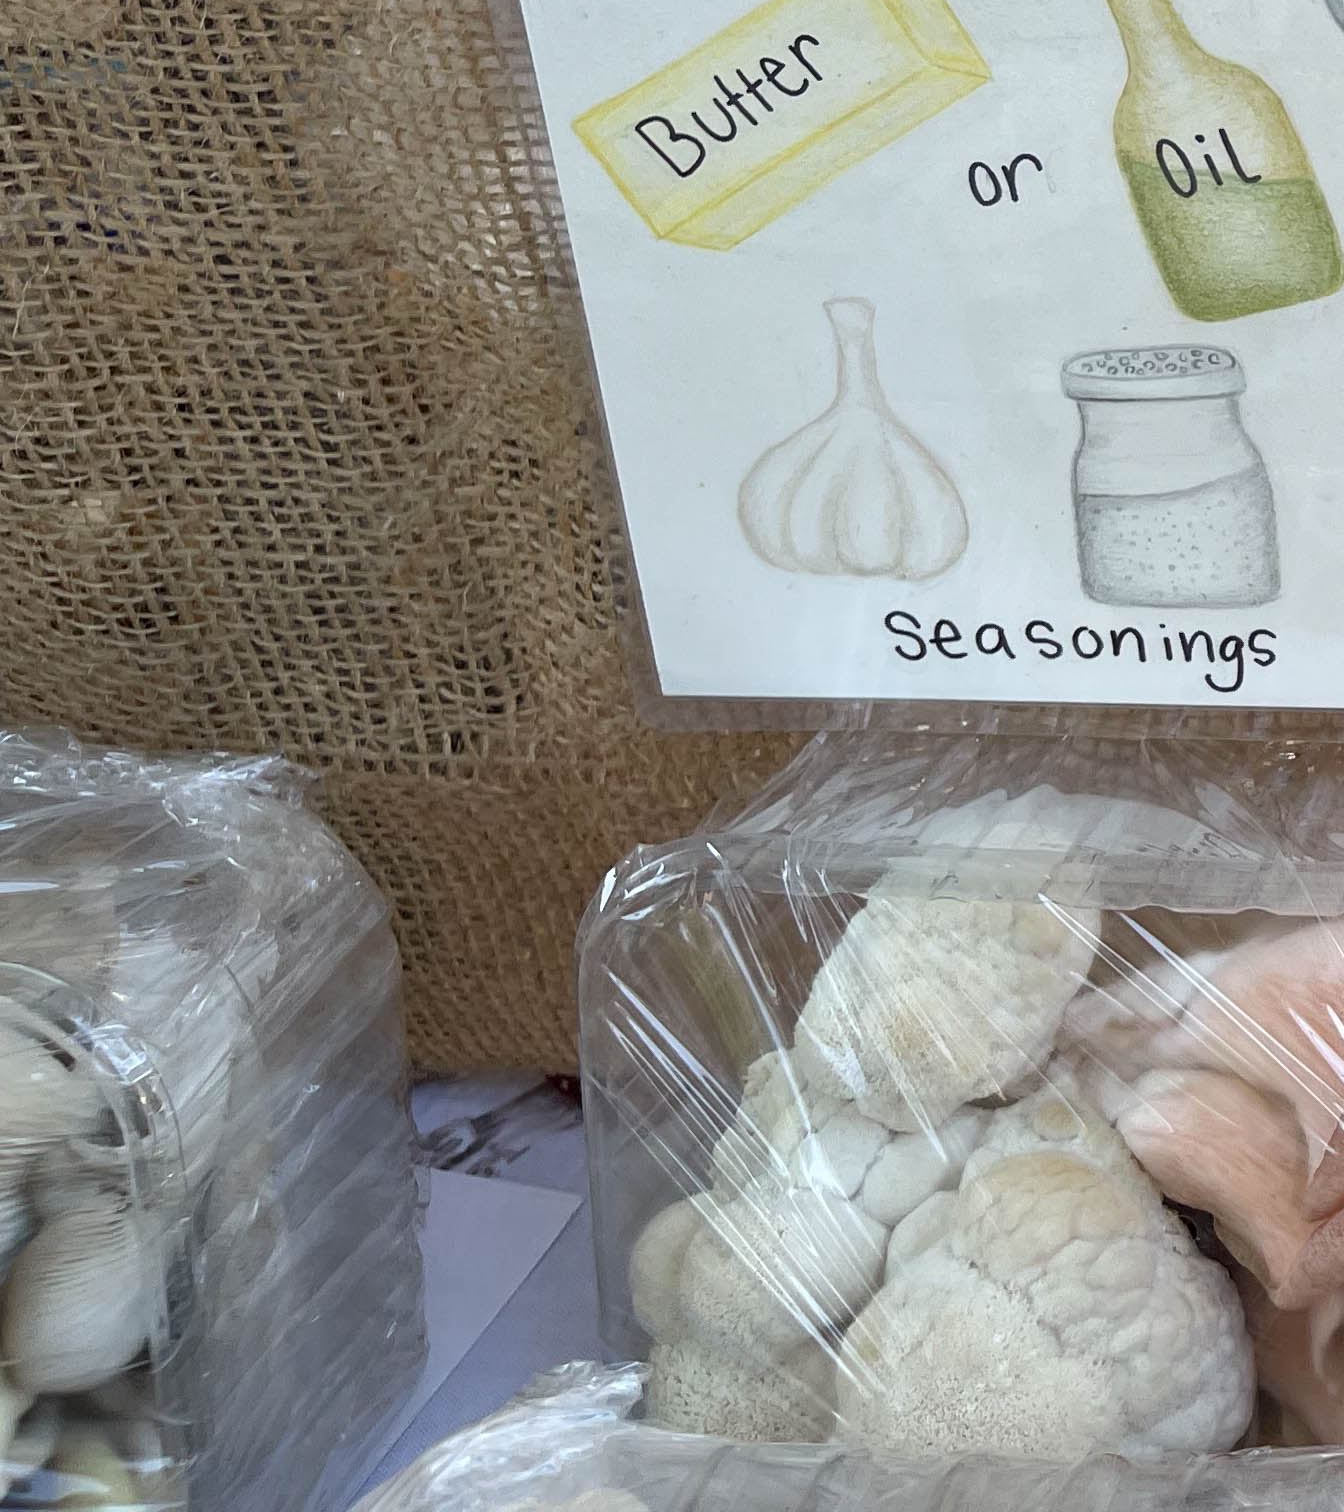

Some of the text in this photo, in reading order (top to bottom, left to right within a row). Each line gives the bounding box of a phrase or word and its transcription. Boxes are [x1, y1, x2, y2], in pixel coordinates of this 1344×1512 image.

[634, 34, 823, 178] Butter
[967, 154, 1043, 207] or
[1155, 128, 1262, 199] Oil
